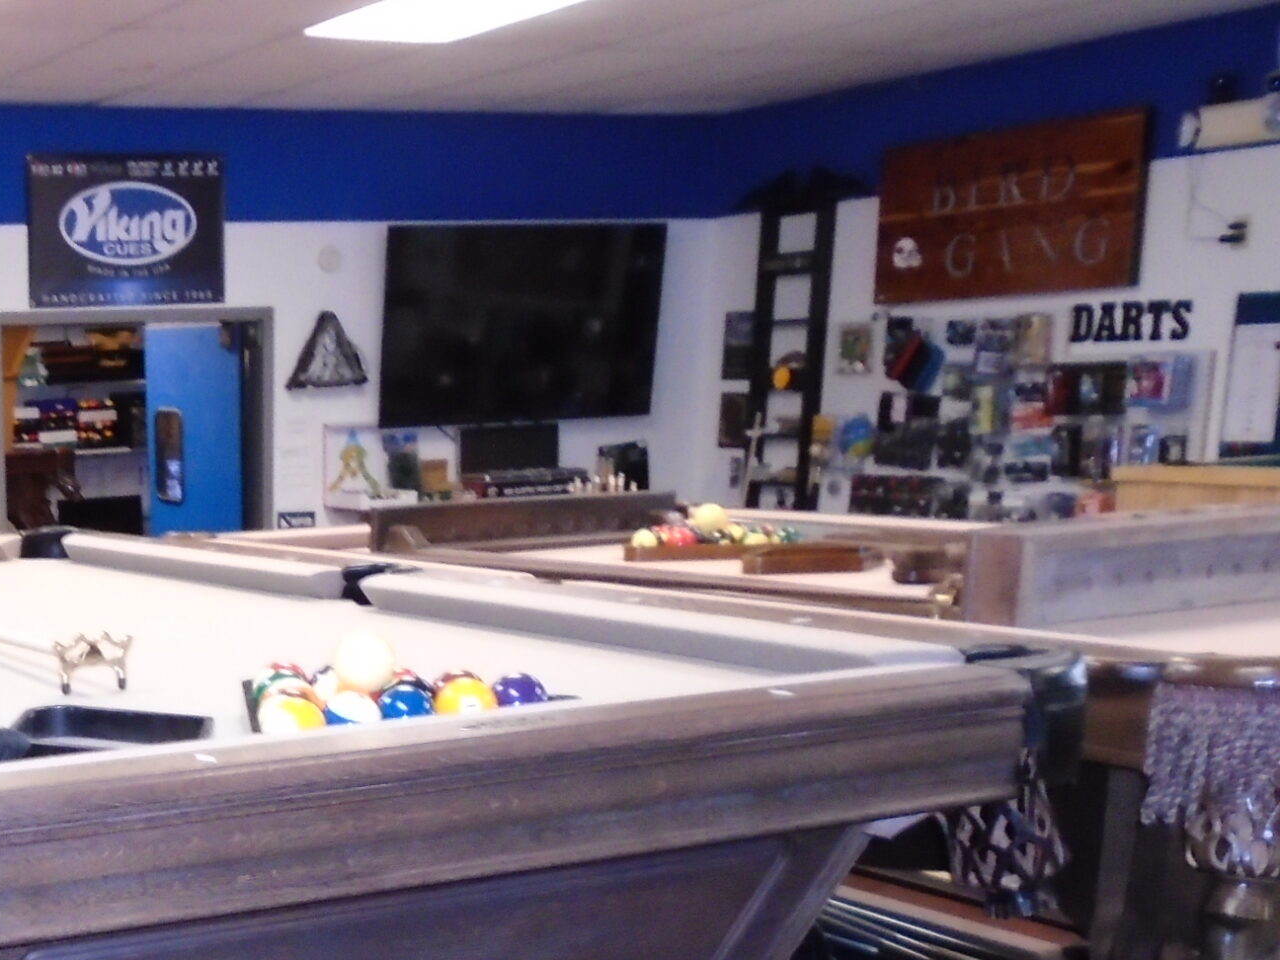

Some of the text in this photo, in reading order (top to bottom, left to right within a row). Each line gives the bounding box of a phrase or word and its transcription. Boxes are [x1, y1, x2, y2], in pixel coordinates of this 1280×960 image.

[930, 155, 1078, 214] BIRD
[71, 187, 187, 255] Viking
[103, 242, 154, 257] CUES
[41, 292, 138, 304] HANDCRAF
[1070, 300, 1193, 342] DARTS
